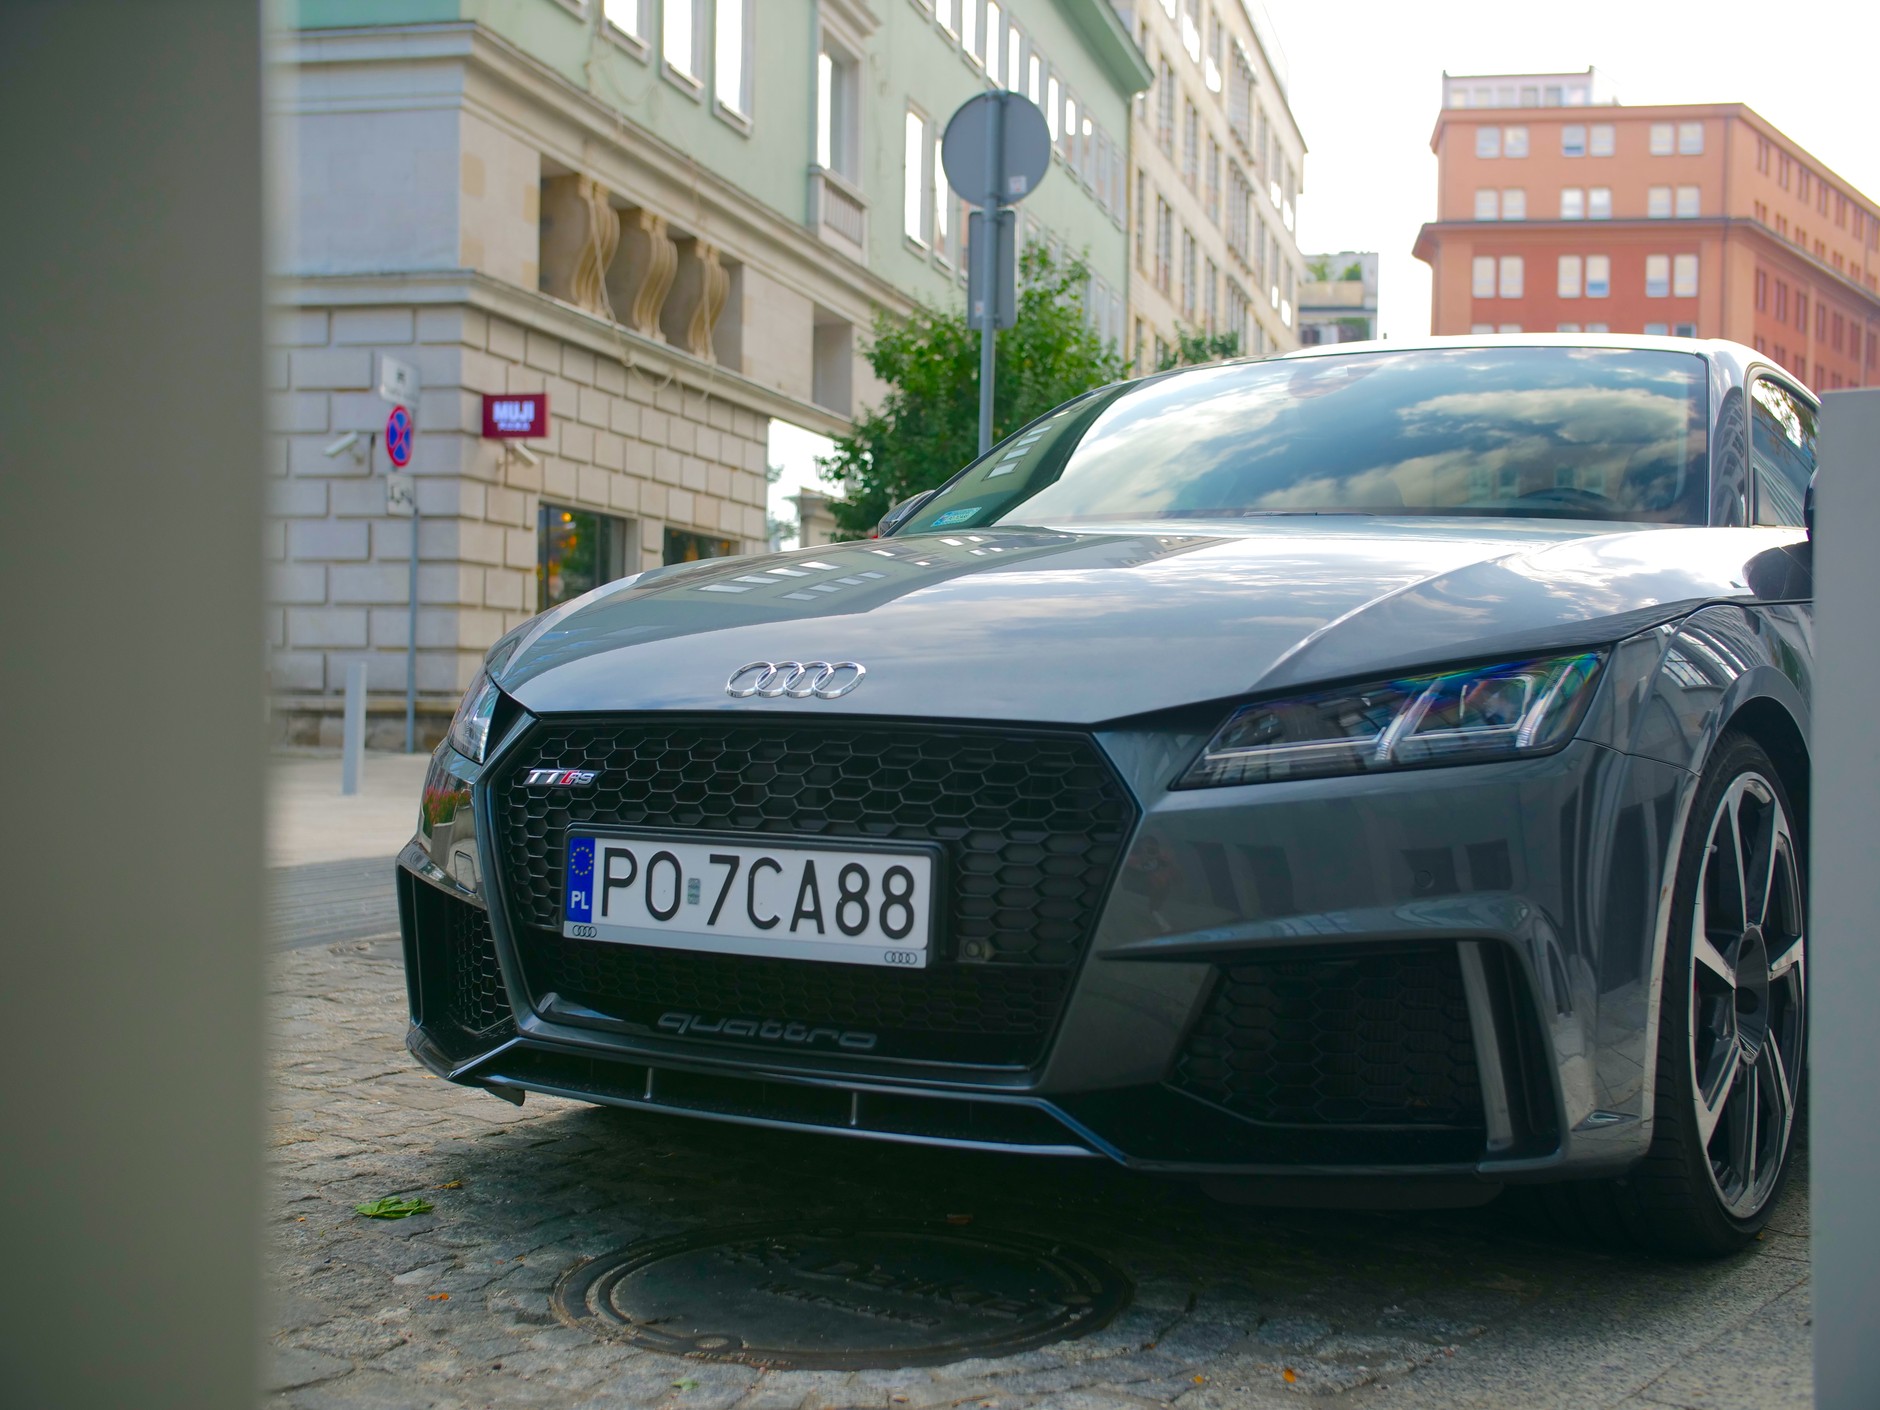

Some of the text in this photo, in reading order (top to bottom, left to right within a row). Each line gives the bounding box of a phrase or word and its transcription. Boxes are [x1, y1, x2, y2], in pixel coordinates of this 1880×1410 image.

[493, 400, 535, 423] MUJI
[570, 890, 590, 911] PL
[657, 1011, 878, 1049] quattro
